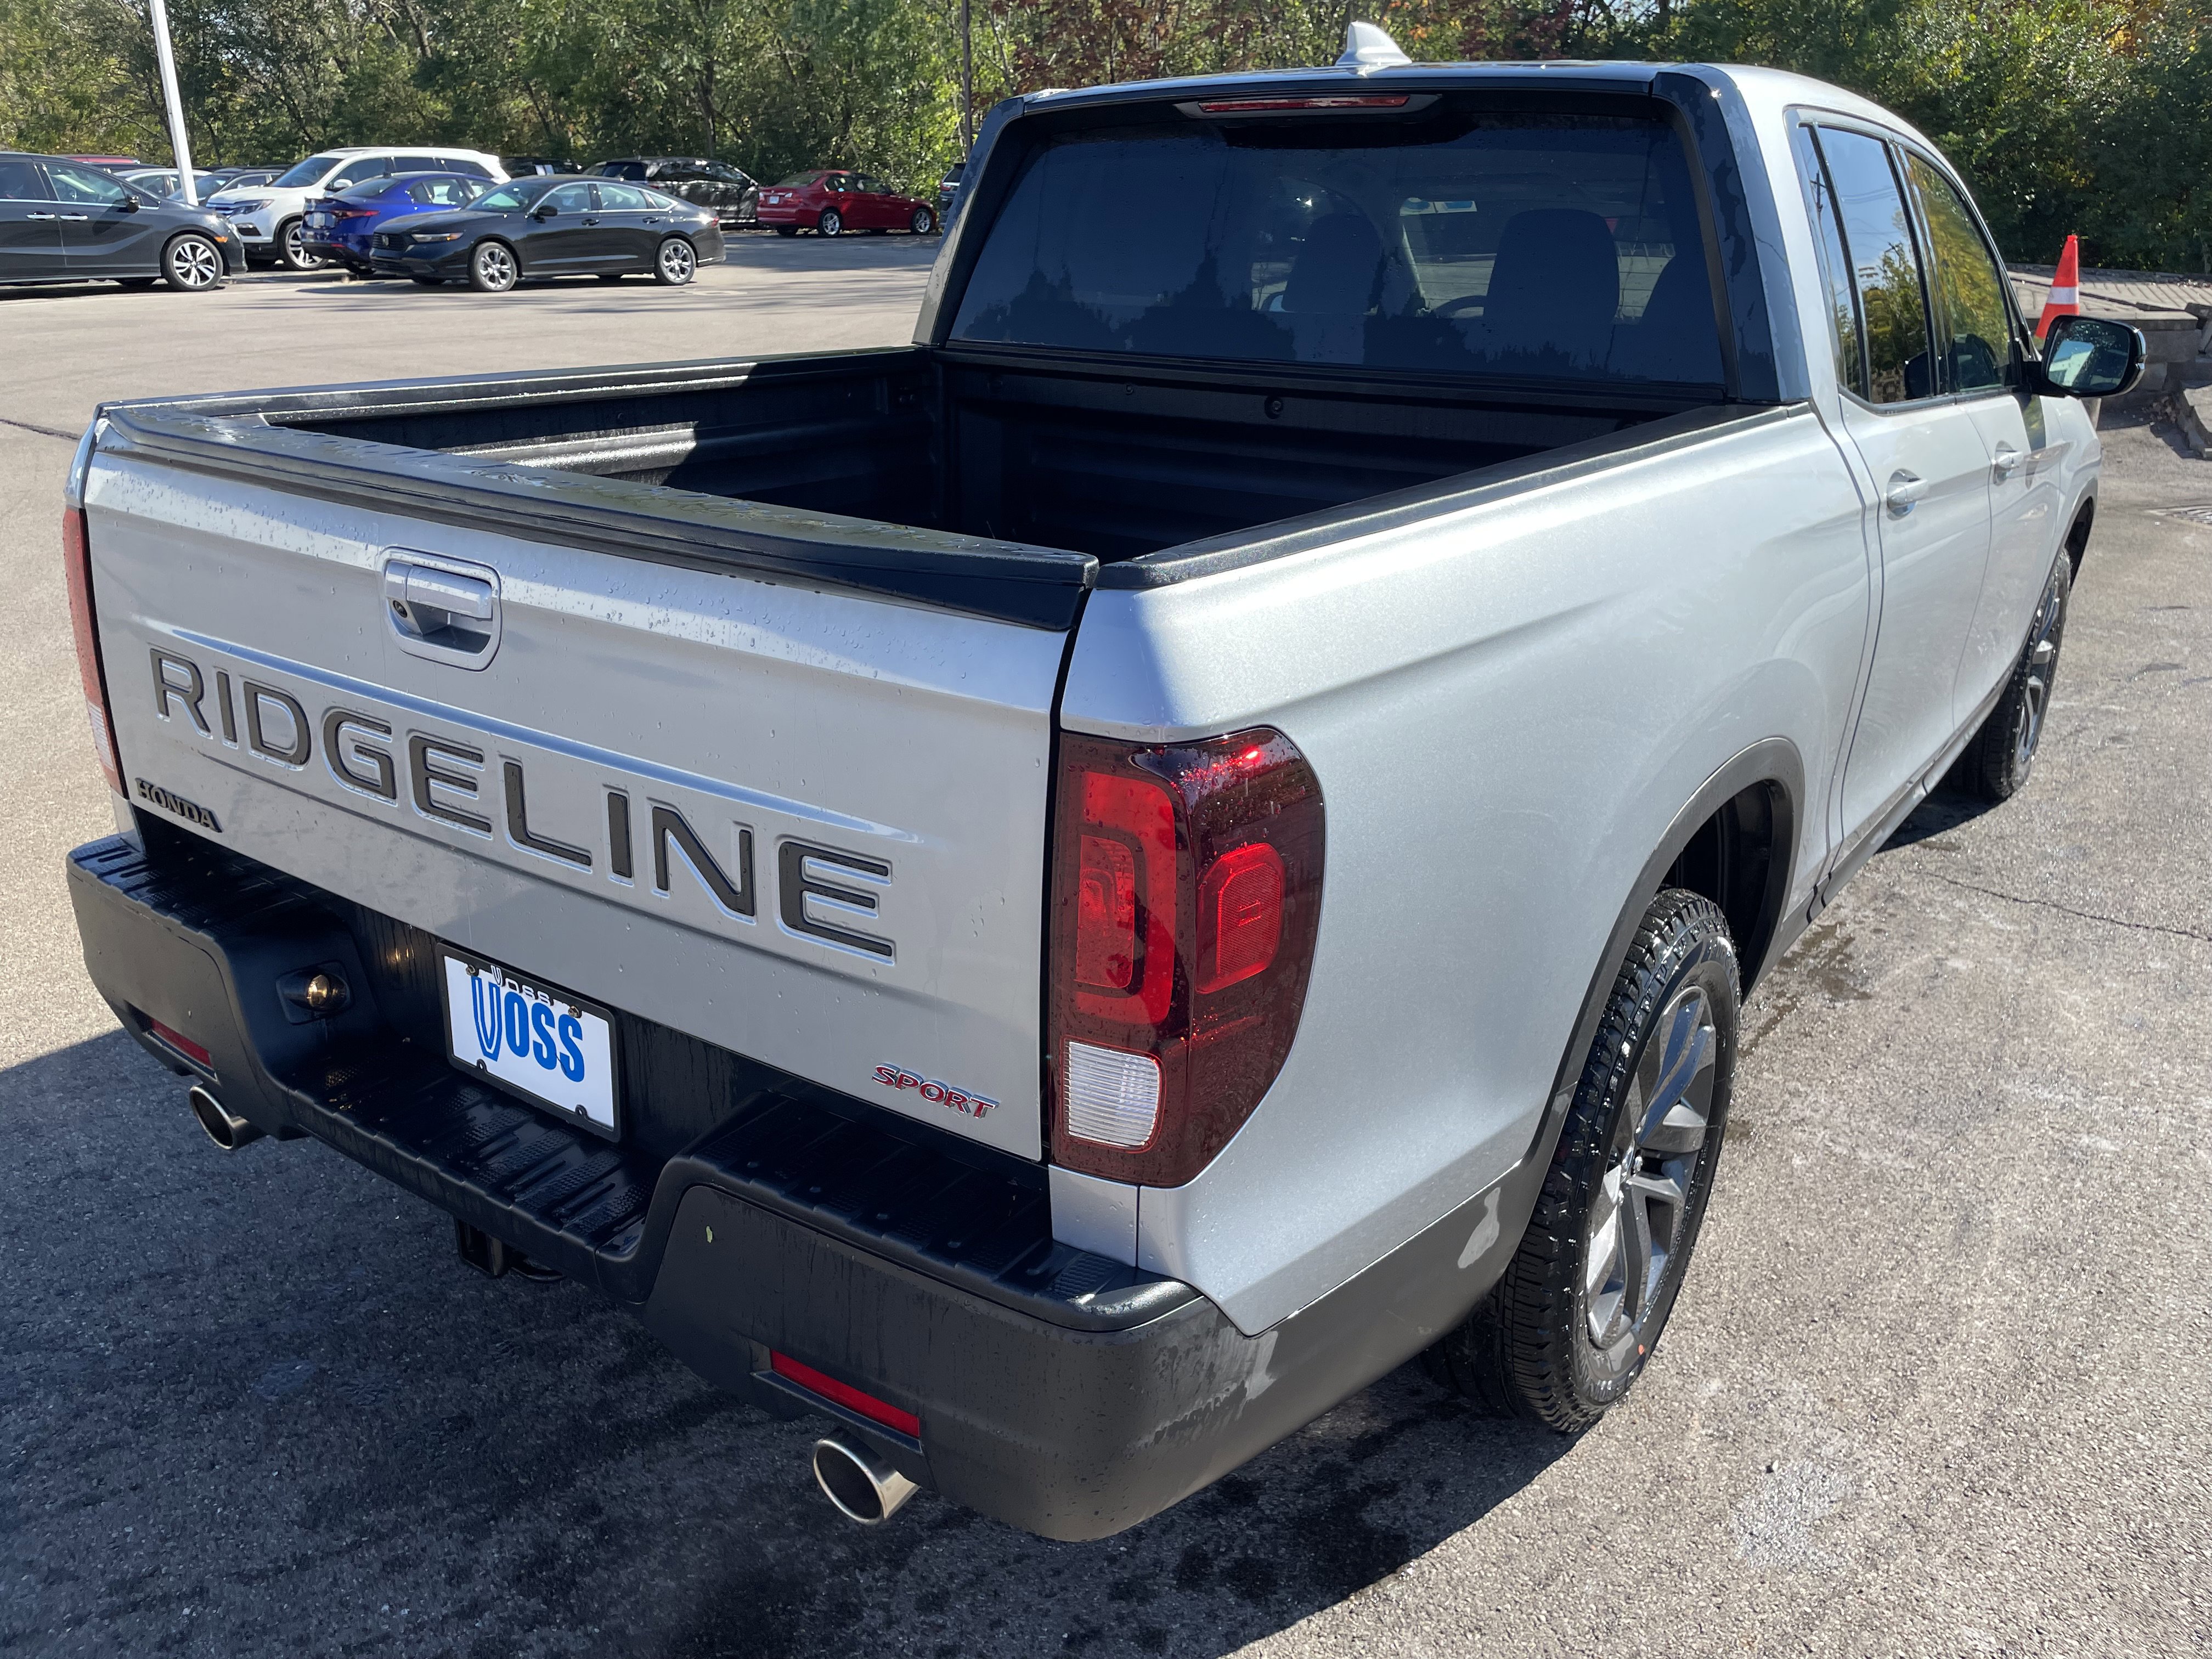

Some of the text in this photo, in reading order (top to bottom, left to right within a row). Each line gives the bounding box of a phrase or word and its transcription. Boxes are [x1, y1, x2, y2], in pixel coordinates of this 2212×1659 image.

[136, 777, 223, 833] HONDA
[149, 648, 893, 958] RIDGELINE
[471, 975, 585, 1083] VOSS
[872, 1062, 1000, 1119] SPORT
